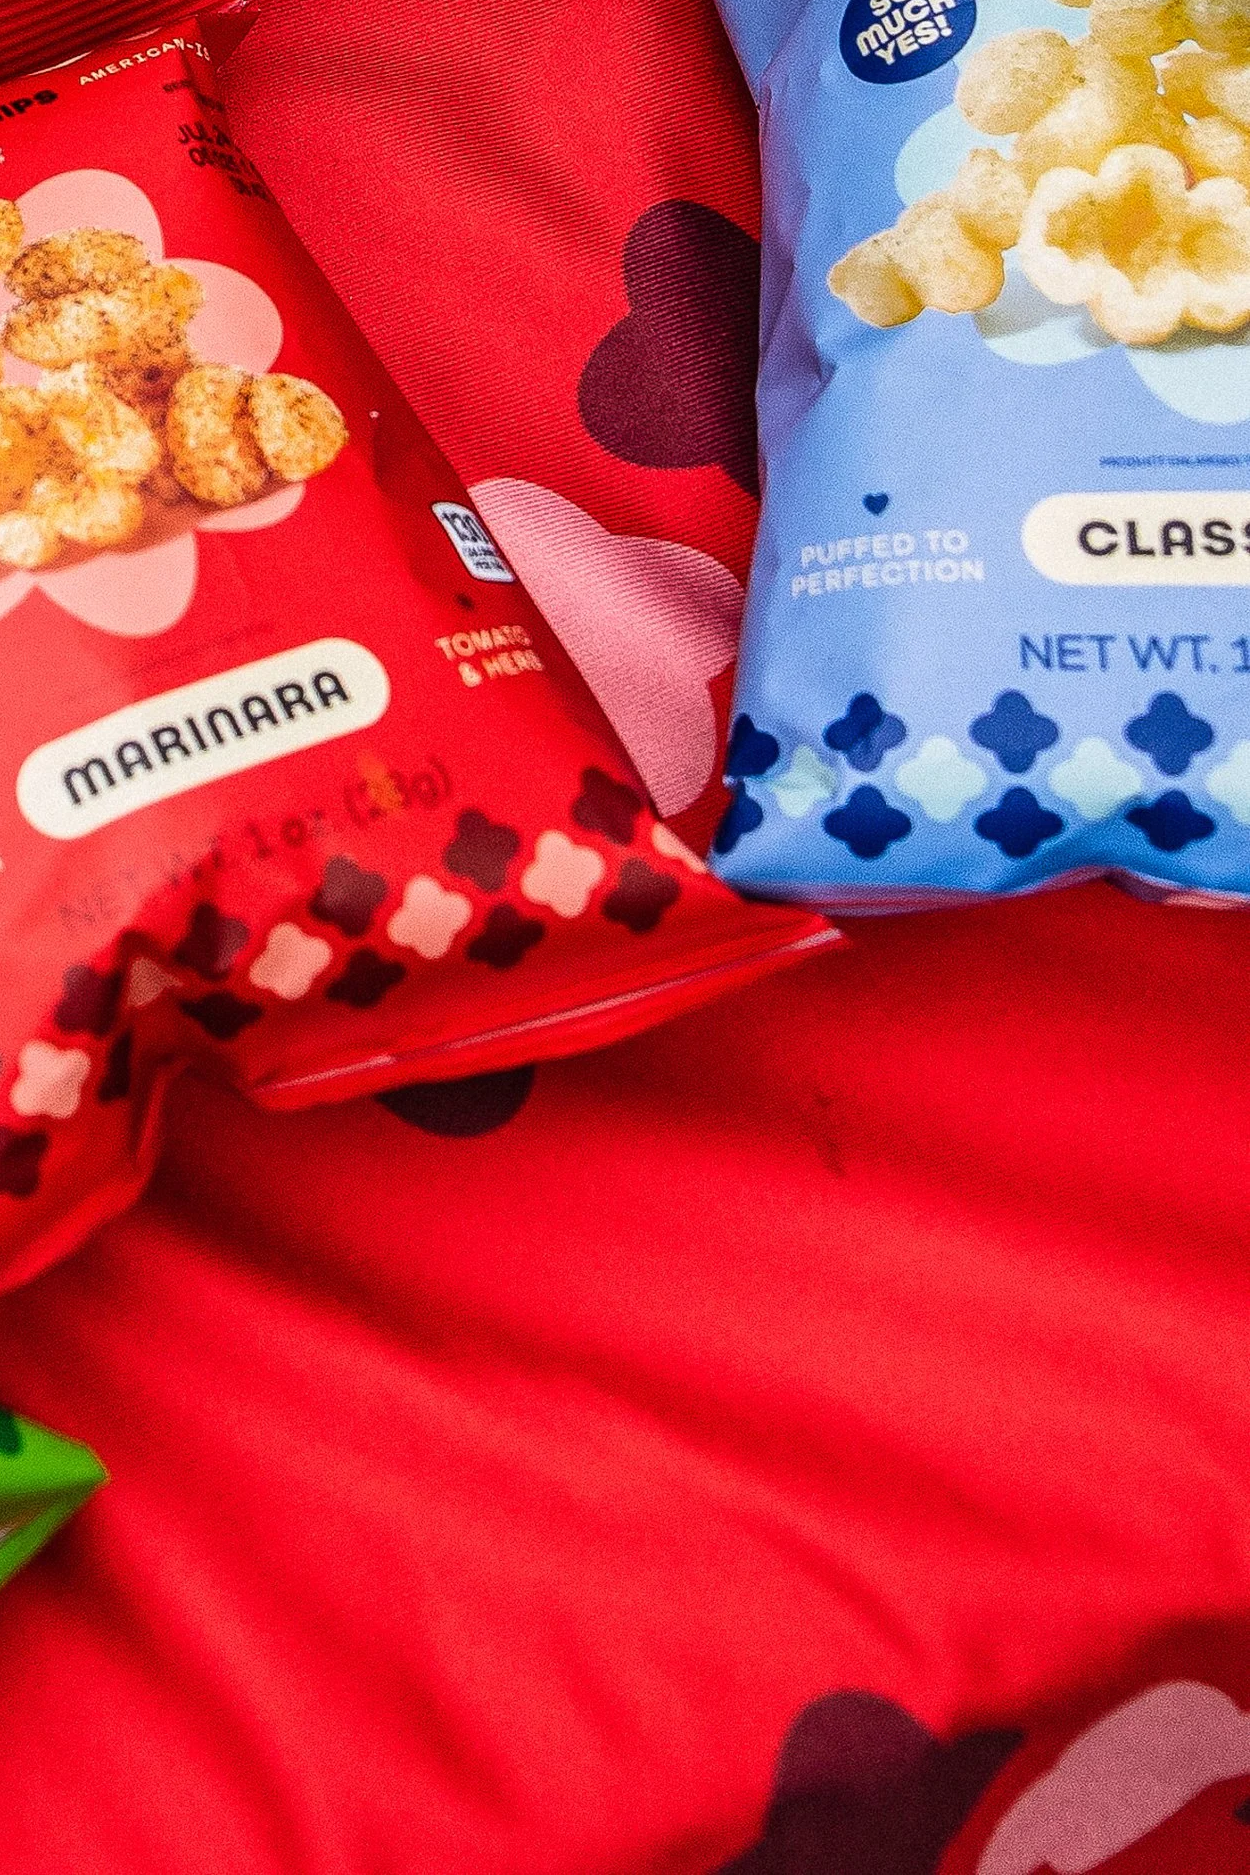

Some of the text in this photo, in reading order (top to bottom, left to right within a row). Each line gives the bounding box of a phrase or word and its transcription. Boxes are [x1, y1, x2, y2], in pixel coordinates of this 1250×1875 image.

[874, 14, 953, 67] YES!
[801, 529, 969, 568] PUFFED TO
[1078, 519, 1250, 556] CLAS
[790, 559, 985, 598] PERFECTION
[434, 625, 533, 661] TOMATO
[1019, 633, 1114, 671] NET
[1126, 633, 1220, 673] WT.
[61, 670, 352, 806] MARINARA
